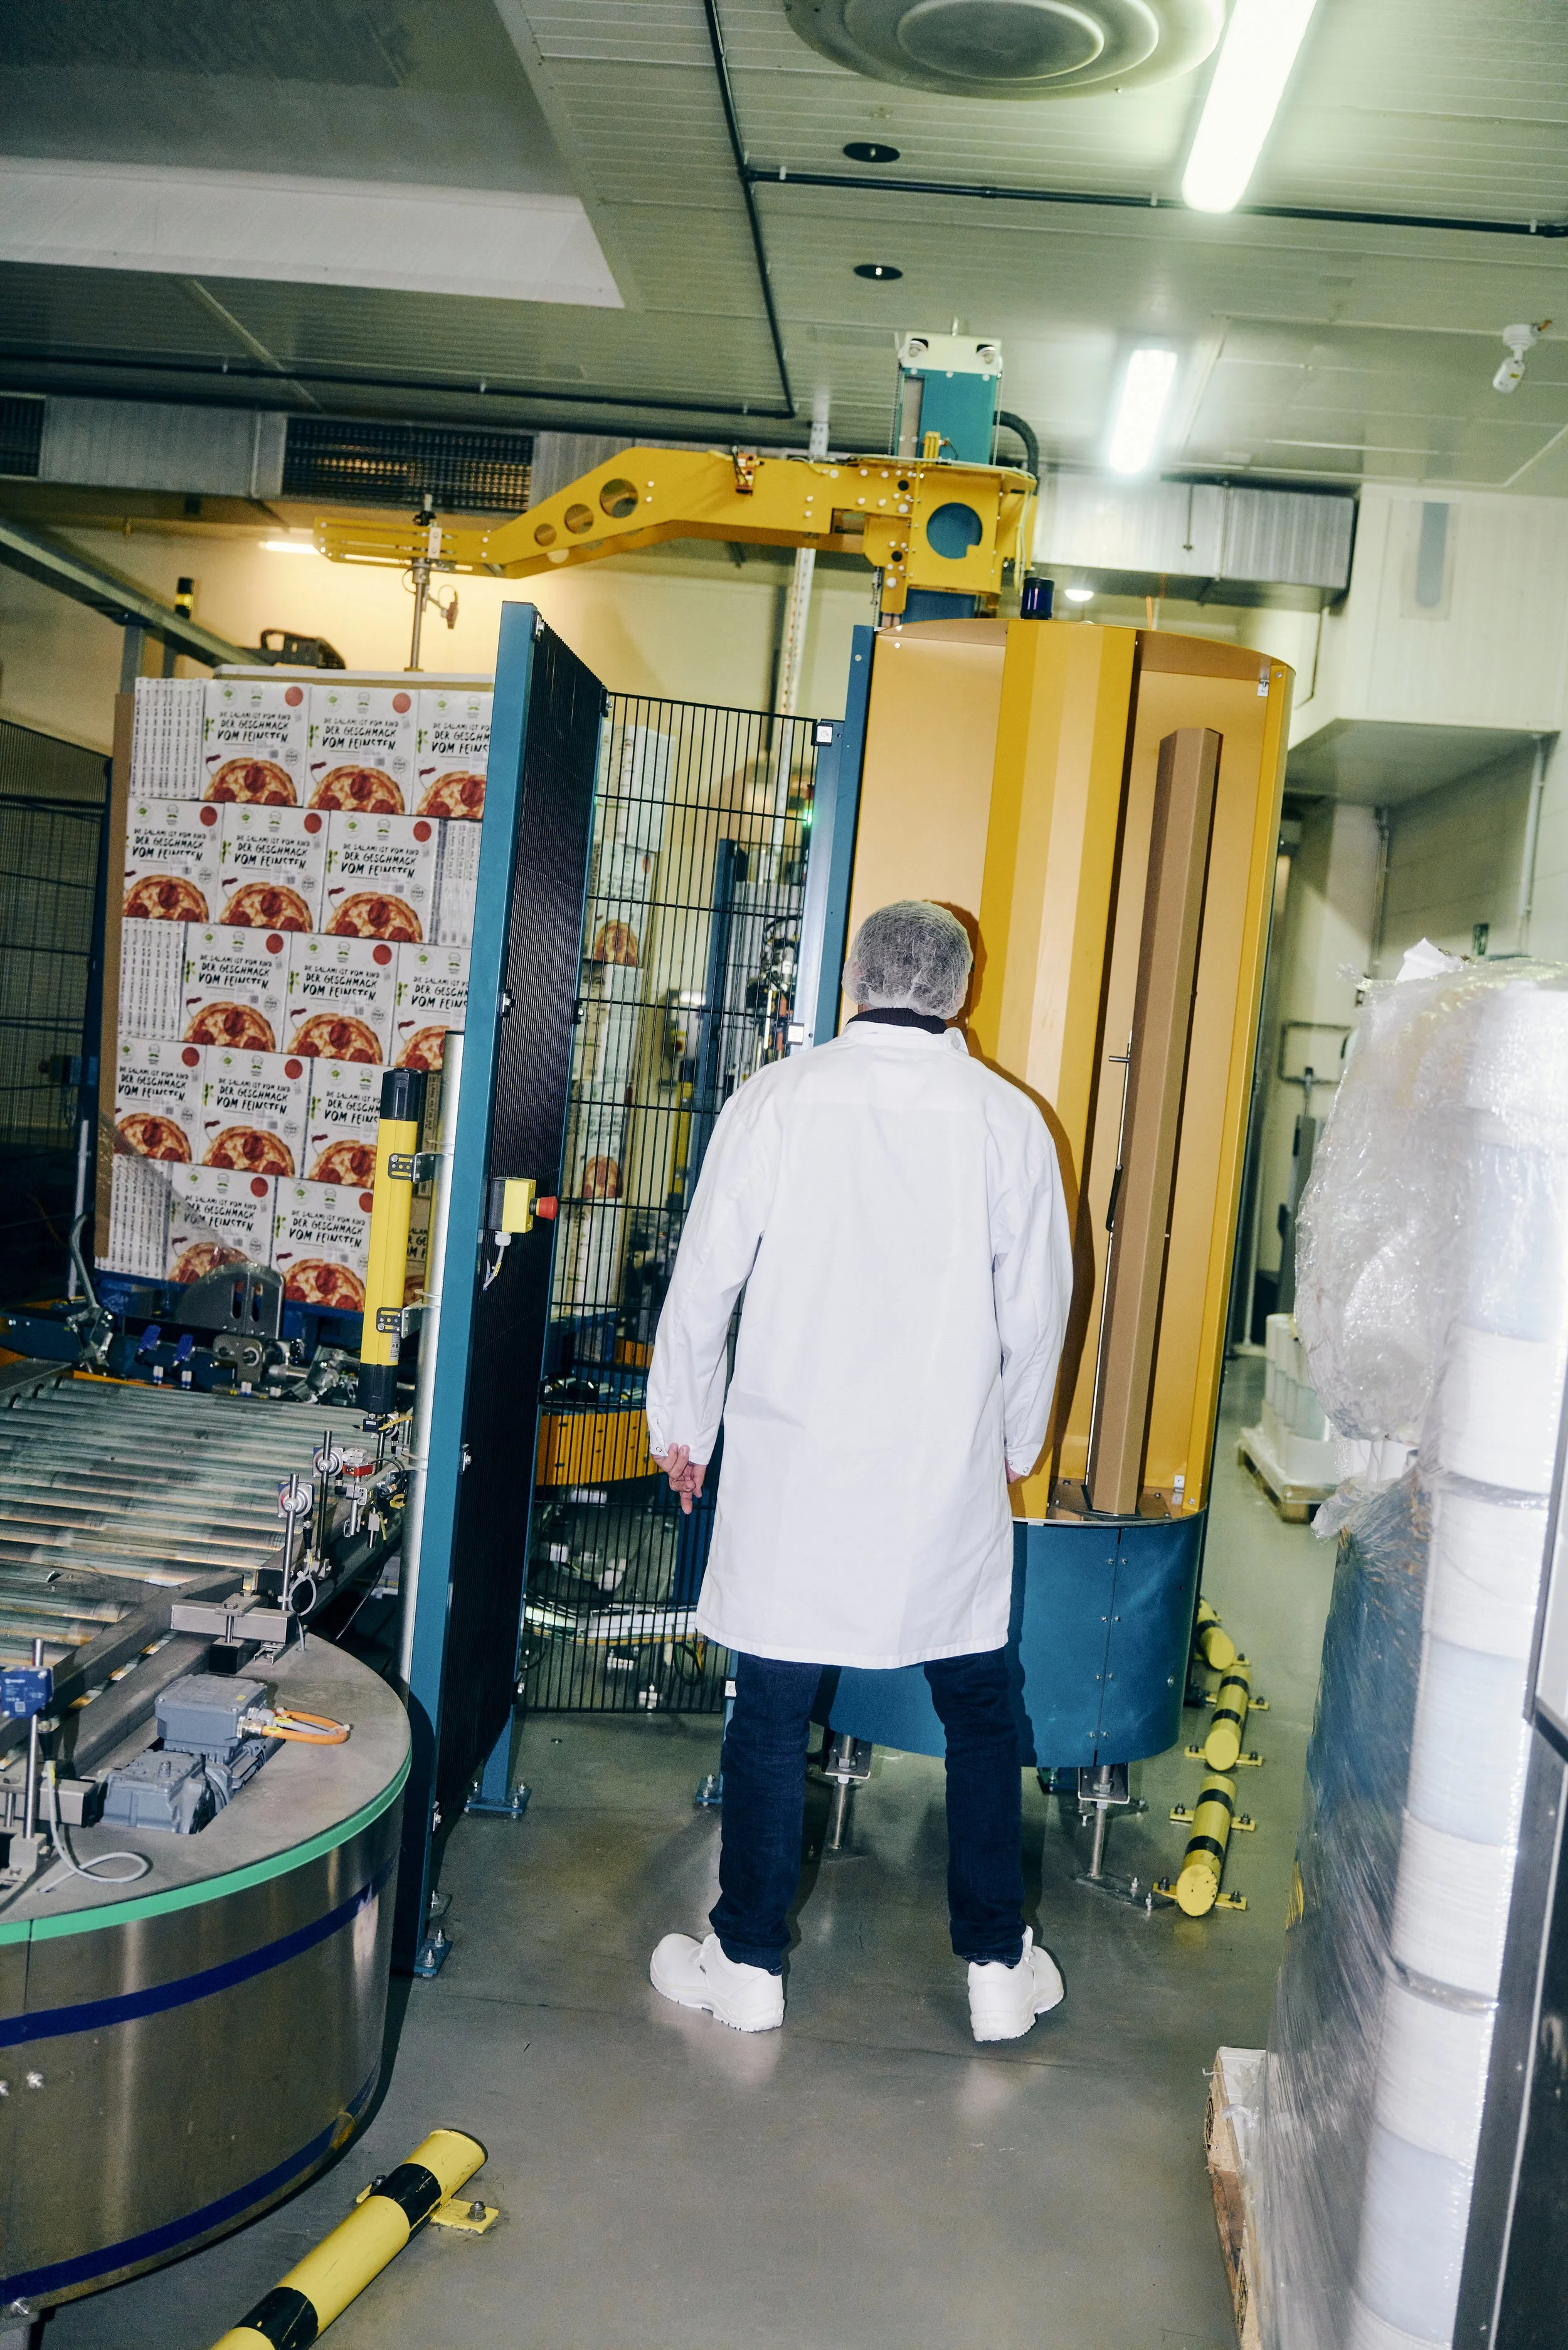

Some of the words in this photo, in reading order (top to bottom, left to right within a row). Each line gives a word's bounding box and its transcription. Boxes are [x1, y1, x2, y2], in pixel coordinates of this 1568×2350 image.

[221, 719, 234, 728] DER
[238, 720, 288, 730] GESCHMACK
[218, 729, 240, 741] VOM
[325, 726, 339, 734] DER
[343, 726, 396, 737] GESCHMACK
[435, 731, 450, 739] DER
[322, 736, 346, 748] VOM
[432, 741, 455, 754] VOM
[135, 836, 149, 845] DER
[153, 837, 203, 849] GESCHMACK
[132, 845, 155, 858] VOM
[238, 842, 252, 852] DER
[255, 844, 307, 857] GESCHMACK
[234, 852, 257, 865] VOM
[345, 851, 359, 860] DER
[363, 853, 416, 865] GESCHMACK
[341, 862, 365, 874] VOM
[202, 962, 215, 971] DER
[219, 964, 269, 977] GESCHMACK
[198, 972, 221, 985] VOM
[305, 973, 320, 982] DER
[324, 975, 376, 988] GESCHMACK
[302, 983, 326, 996] VOM
[415, 984, 430, 994] DER
[411, 995, 436, 1008] VOM
[120, 1074, 134, 1083] DER
[137, 1076, 186, 1089] GESCHMACK
[118, 1083, 139, 1096] VOM
[220, 1086, 233, 1095] DER
[237, 1088, 287, 1102] GESCHMACK
[216, 1096, 239, 1109] VOM
[328, 1099, 342, 1109] DER
[324, 1109, 347, 1123] VOM
[204, 1205, 254, 1219] GESCHMACK
[293, 1217, 307, 1227] DER
[311, 1220, 363, 1236] GESCHMACK
[290, 1227, 312, 1241] VOM
